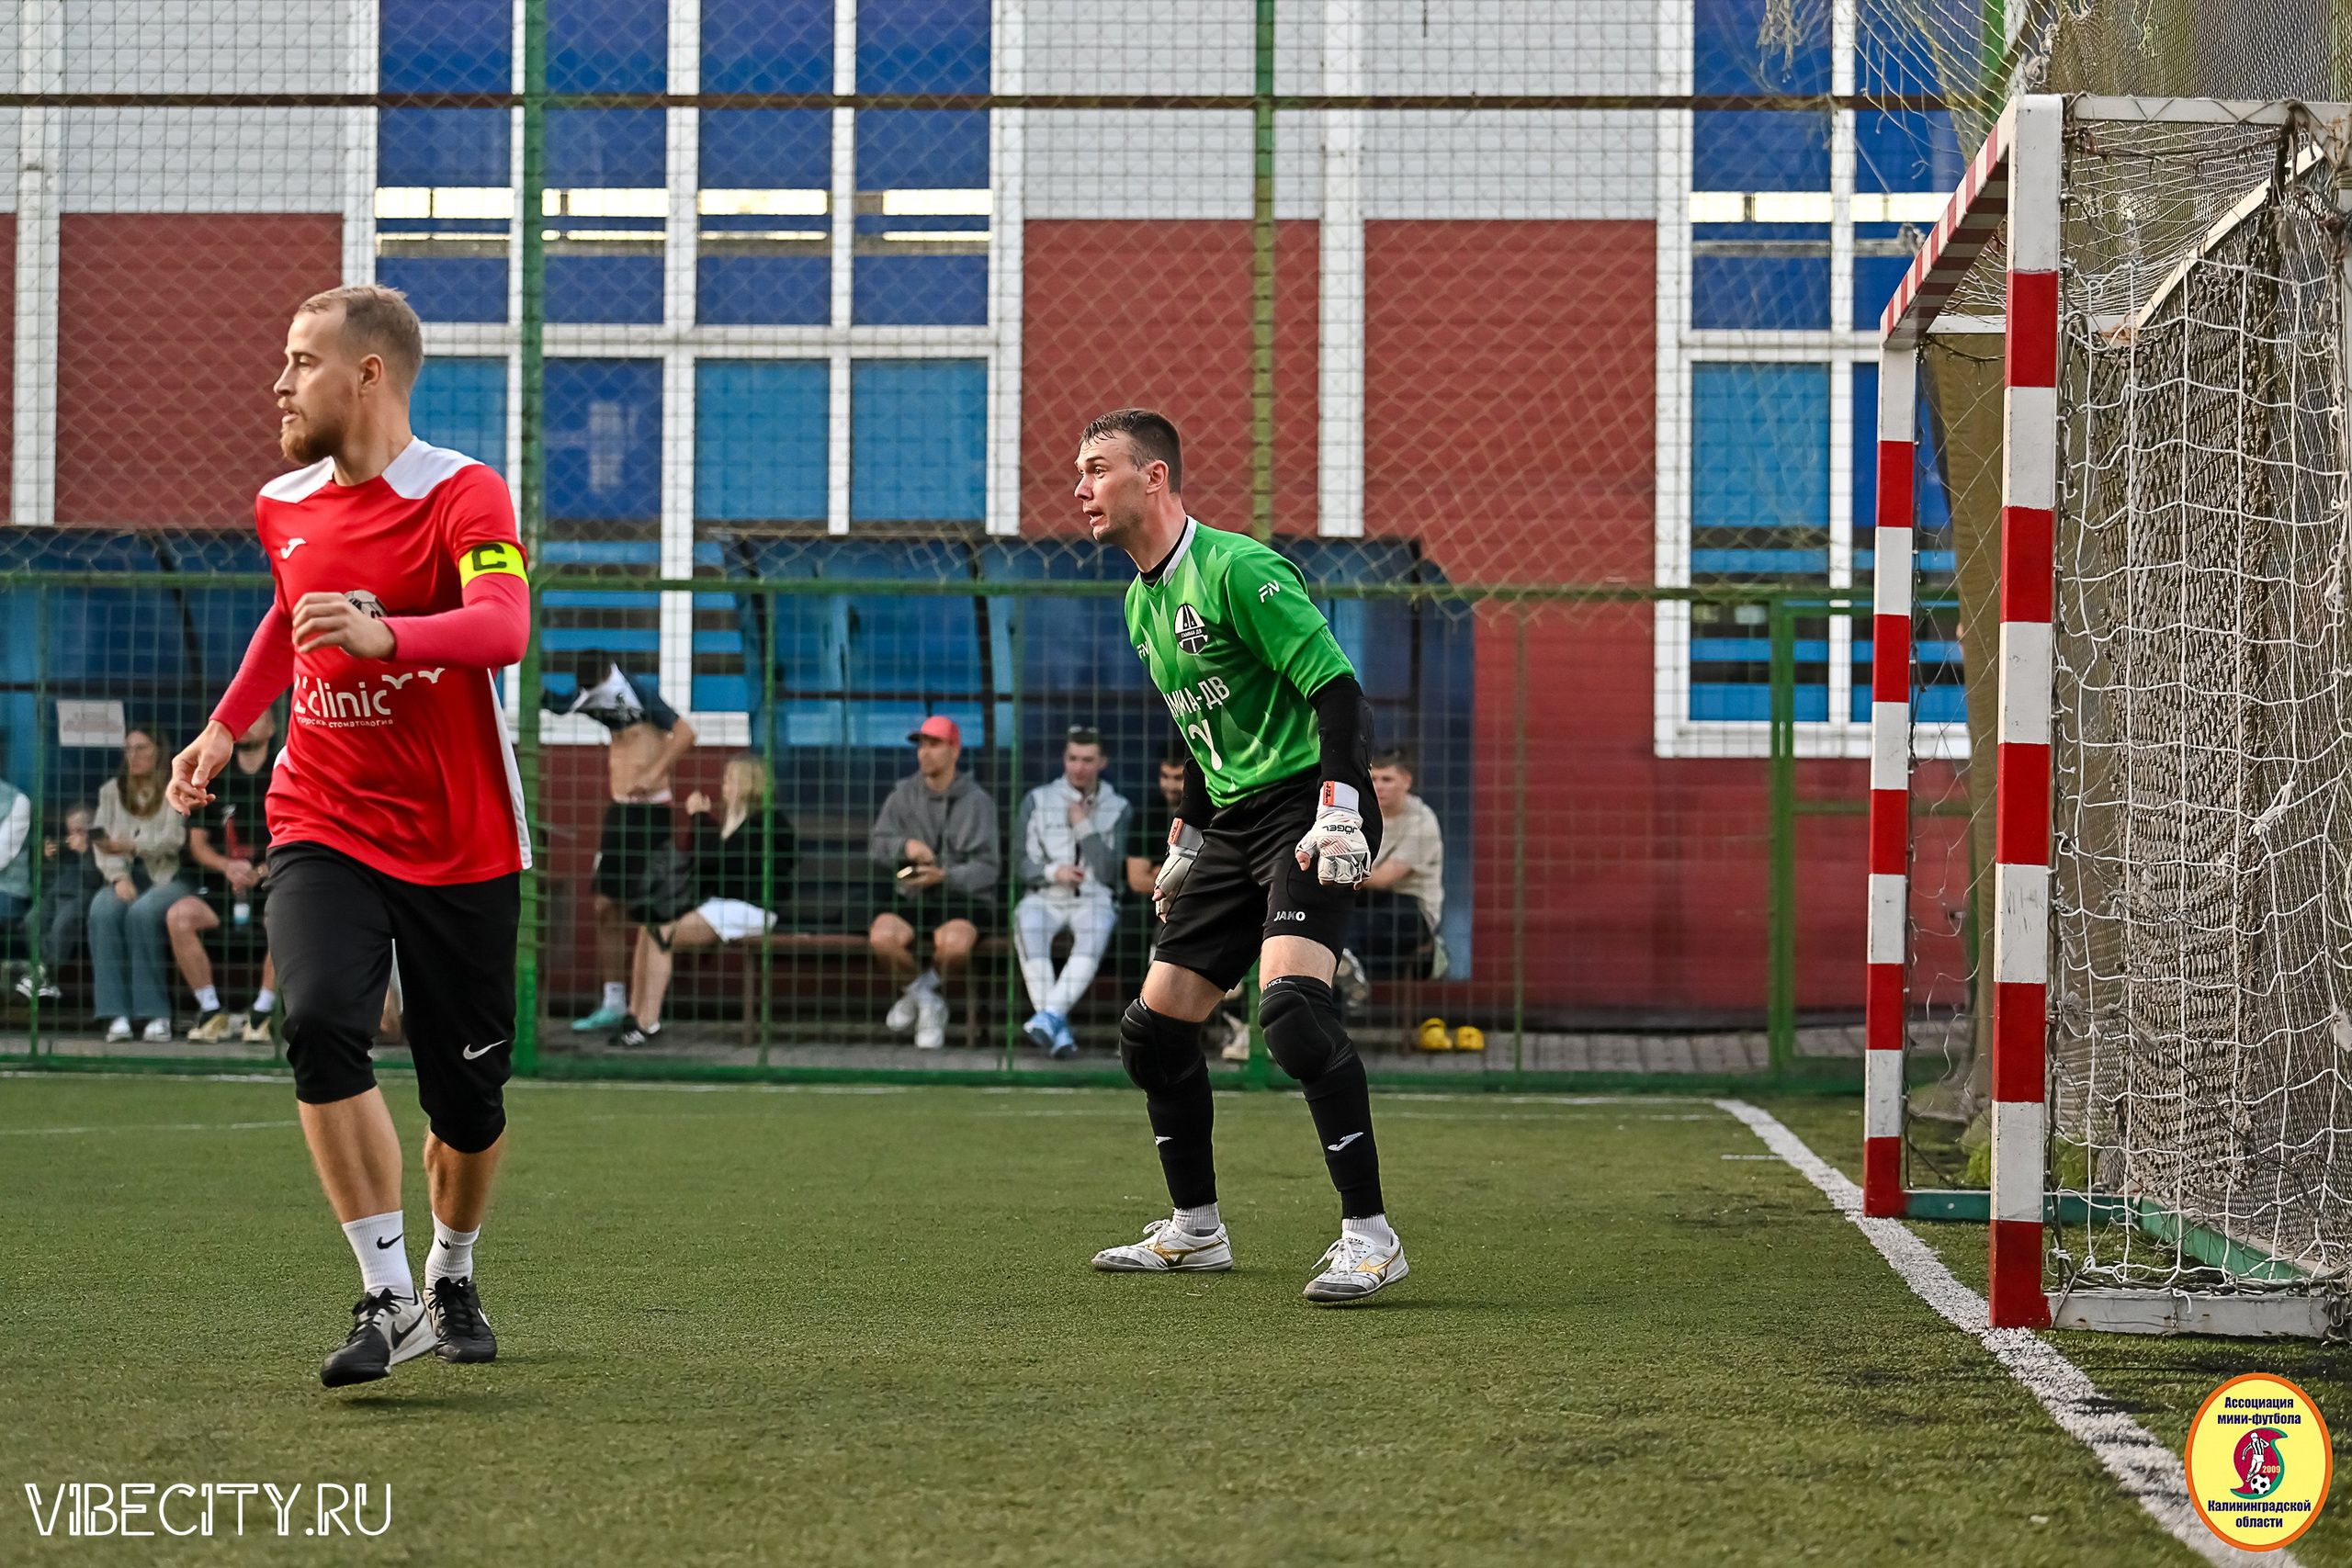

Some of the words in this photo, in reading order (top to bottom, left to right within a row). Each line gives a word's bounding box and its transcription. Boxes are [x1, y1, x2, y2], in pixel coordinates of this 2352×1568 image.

[471, 543, 507, 571] C
[1259, 580, 1280, 604] FN
[1273, 910, 1306, 922] JAKO
